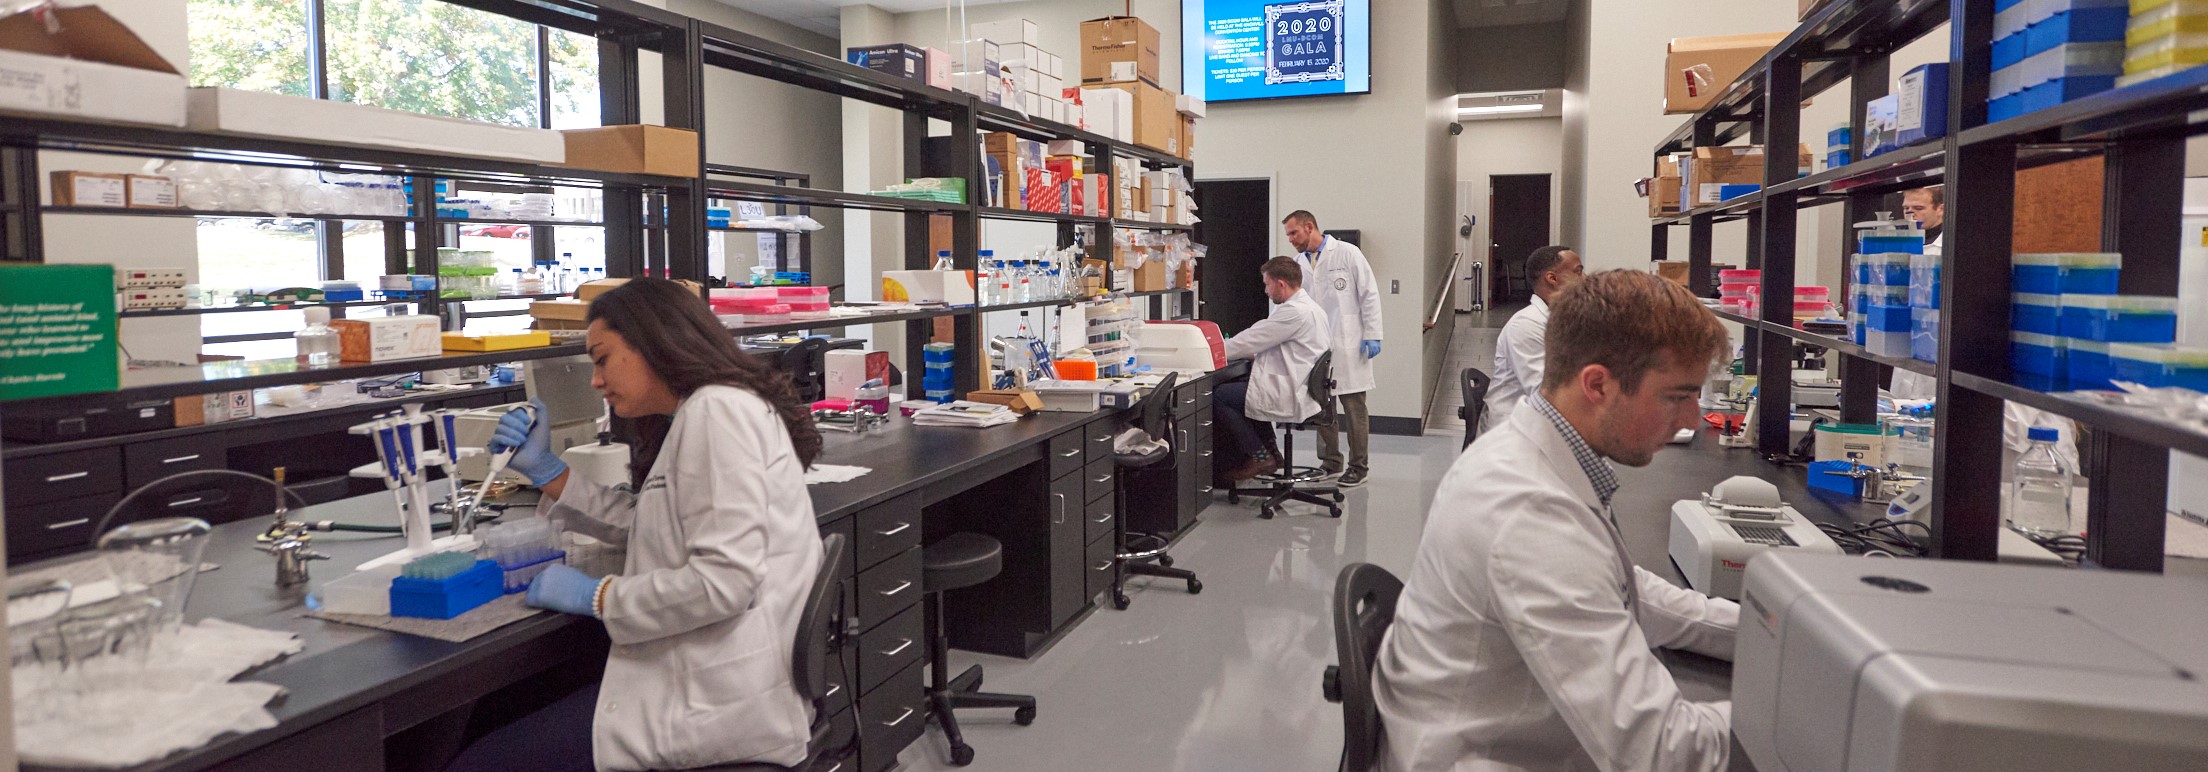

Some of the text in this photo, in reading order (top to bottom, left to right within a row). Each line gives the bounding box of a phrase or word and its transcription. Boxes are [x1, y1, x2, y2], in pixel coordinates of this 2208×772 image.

[1277, 17, 1331, 35] 2020
[1282, 41, 1326, 55] GALA
[1278, 59, 1305, 68] FEBRUARY
